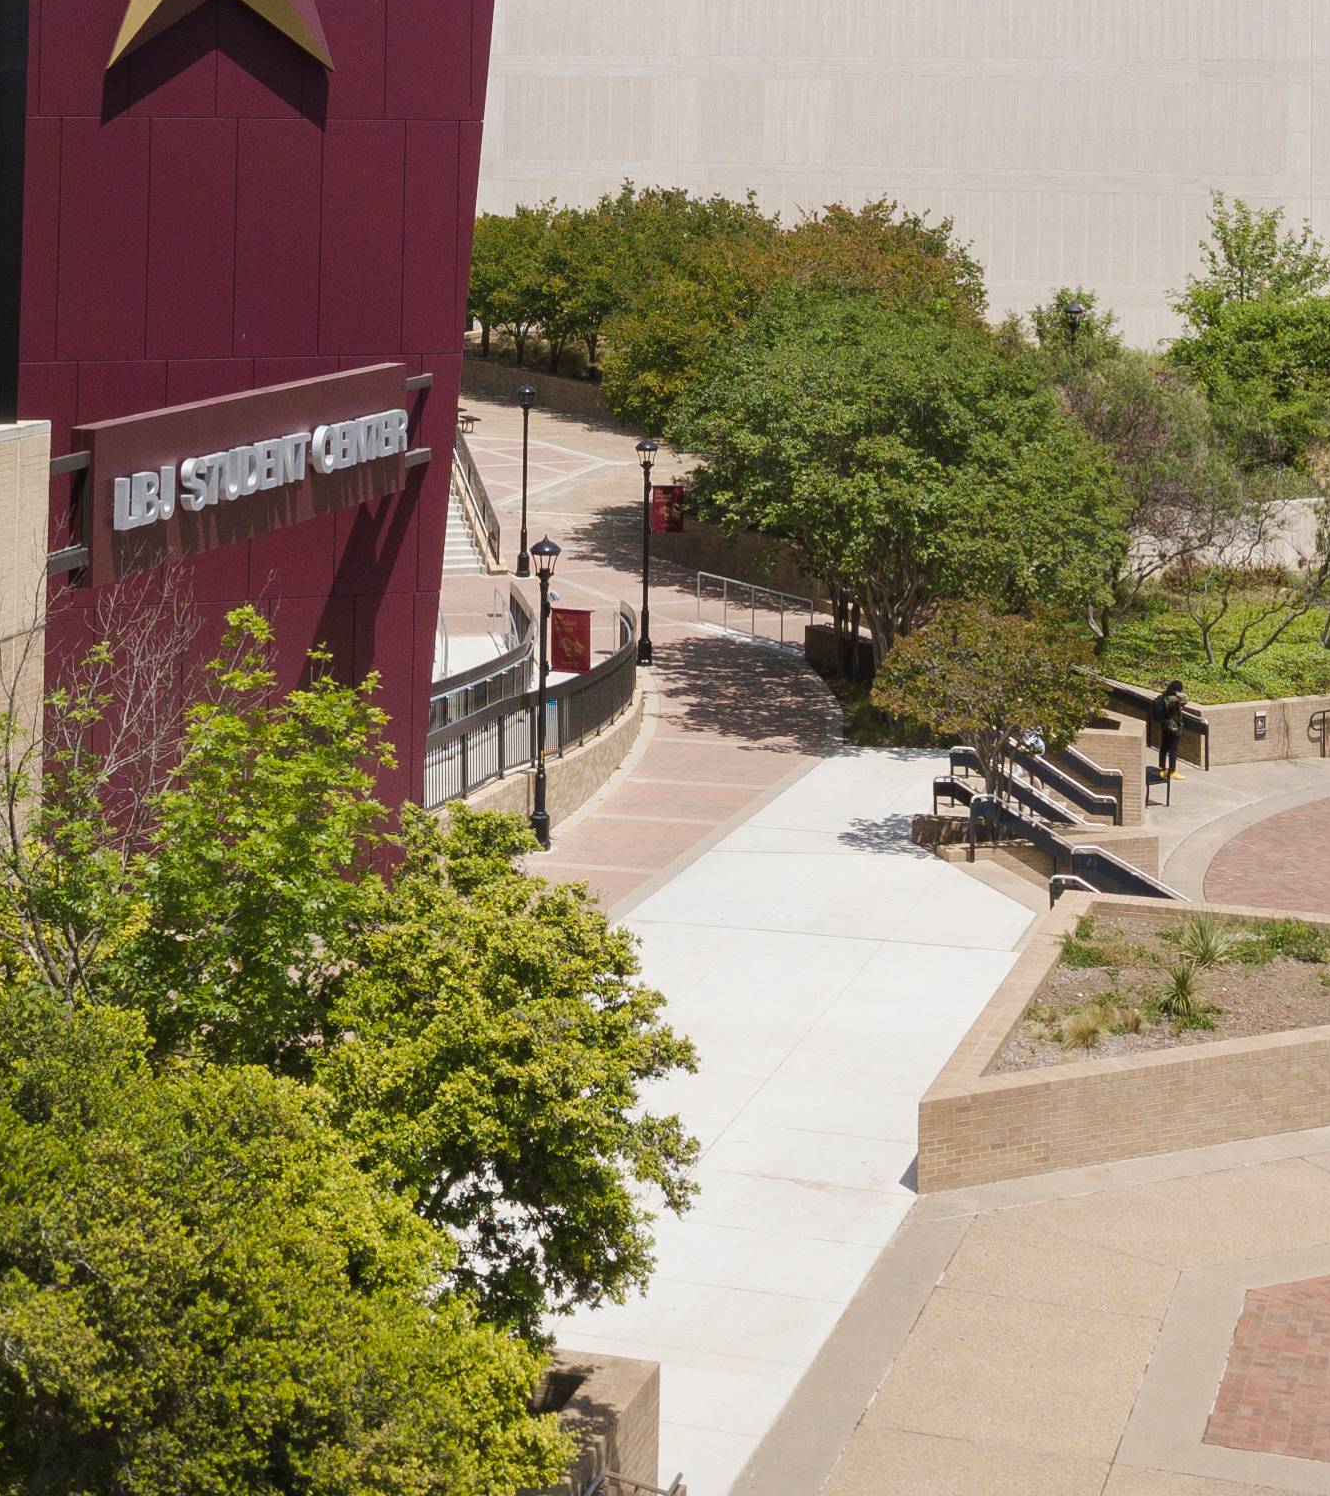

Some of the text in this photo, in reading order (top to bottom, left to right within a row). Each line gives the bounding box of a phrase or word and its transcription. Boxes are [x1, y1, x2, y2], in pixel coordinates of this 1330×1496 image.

[113, 408, 408, 531] LBJ STUDENT CENTER
